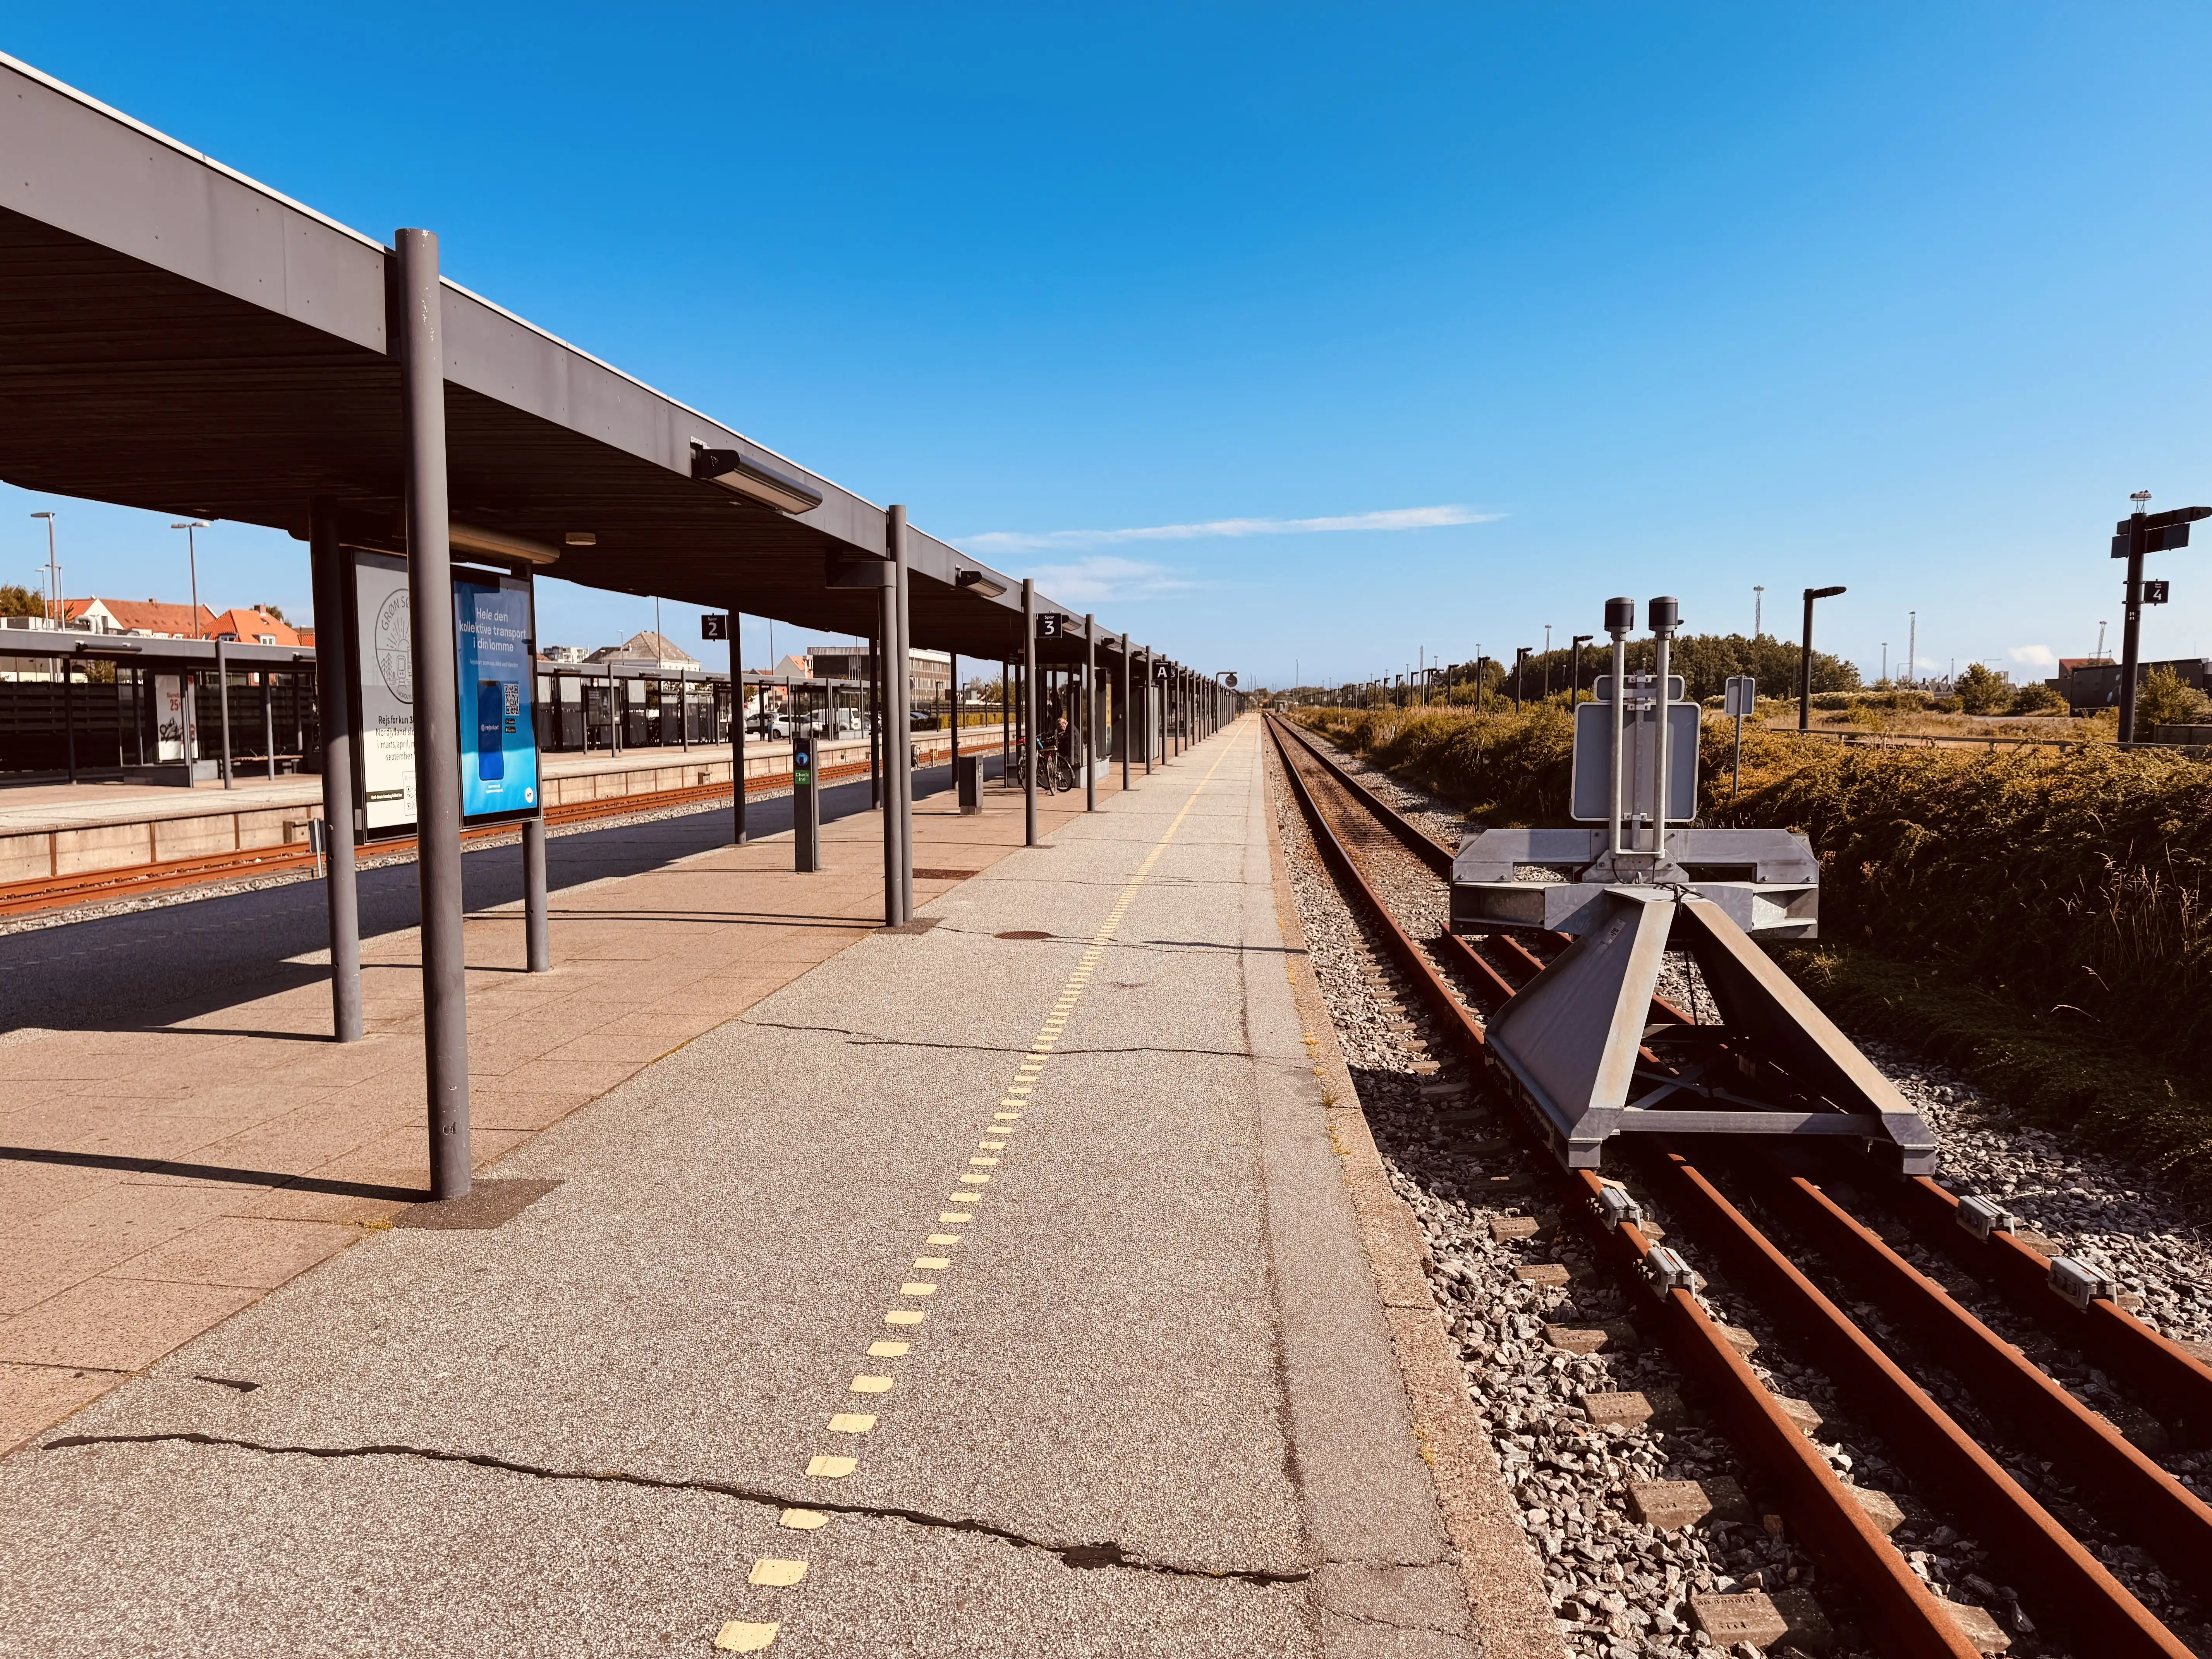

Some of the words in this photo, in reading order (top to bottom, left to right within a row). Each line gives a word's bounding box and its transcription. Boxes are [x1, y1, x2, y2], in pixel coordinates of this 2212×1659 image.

[2153, 589, 2161, 600] 4
[382, 598, 399, 630] GRØN
[476, 607, 492, 620] Hele
[494, 610, 508, 622] den
[459, 620, 491, 635] kollektive
[493, 625, 526, 640] transport
[709, 622, 718, 636] 2
[1045, 621, 1054, 635] 3
[473, 637, 475, 648] i
[477, 637, 488, 649] din
[489, 639, 513, 652] lomme
[1157, 667, 1167, 678] A
[170, 699, 181, 711] 25
[378, 715, 390, 726] Rejs
[399, 715, 408, 724] kun
[376, 727, 406, 738] Nordjylland
[377, 740, 379, 749] i
